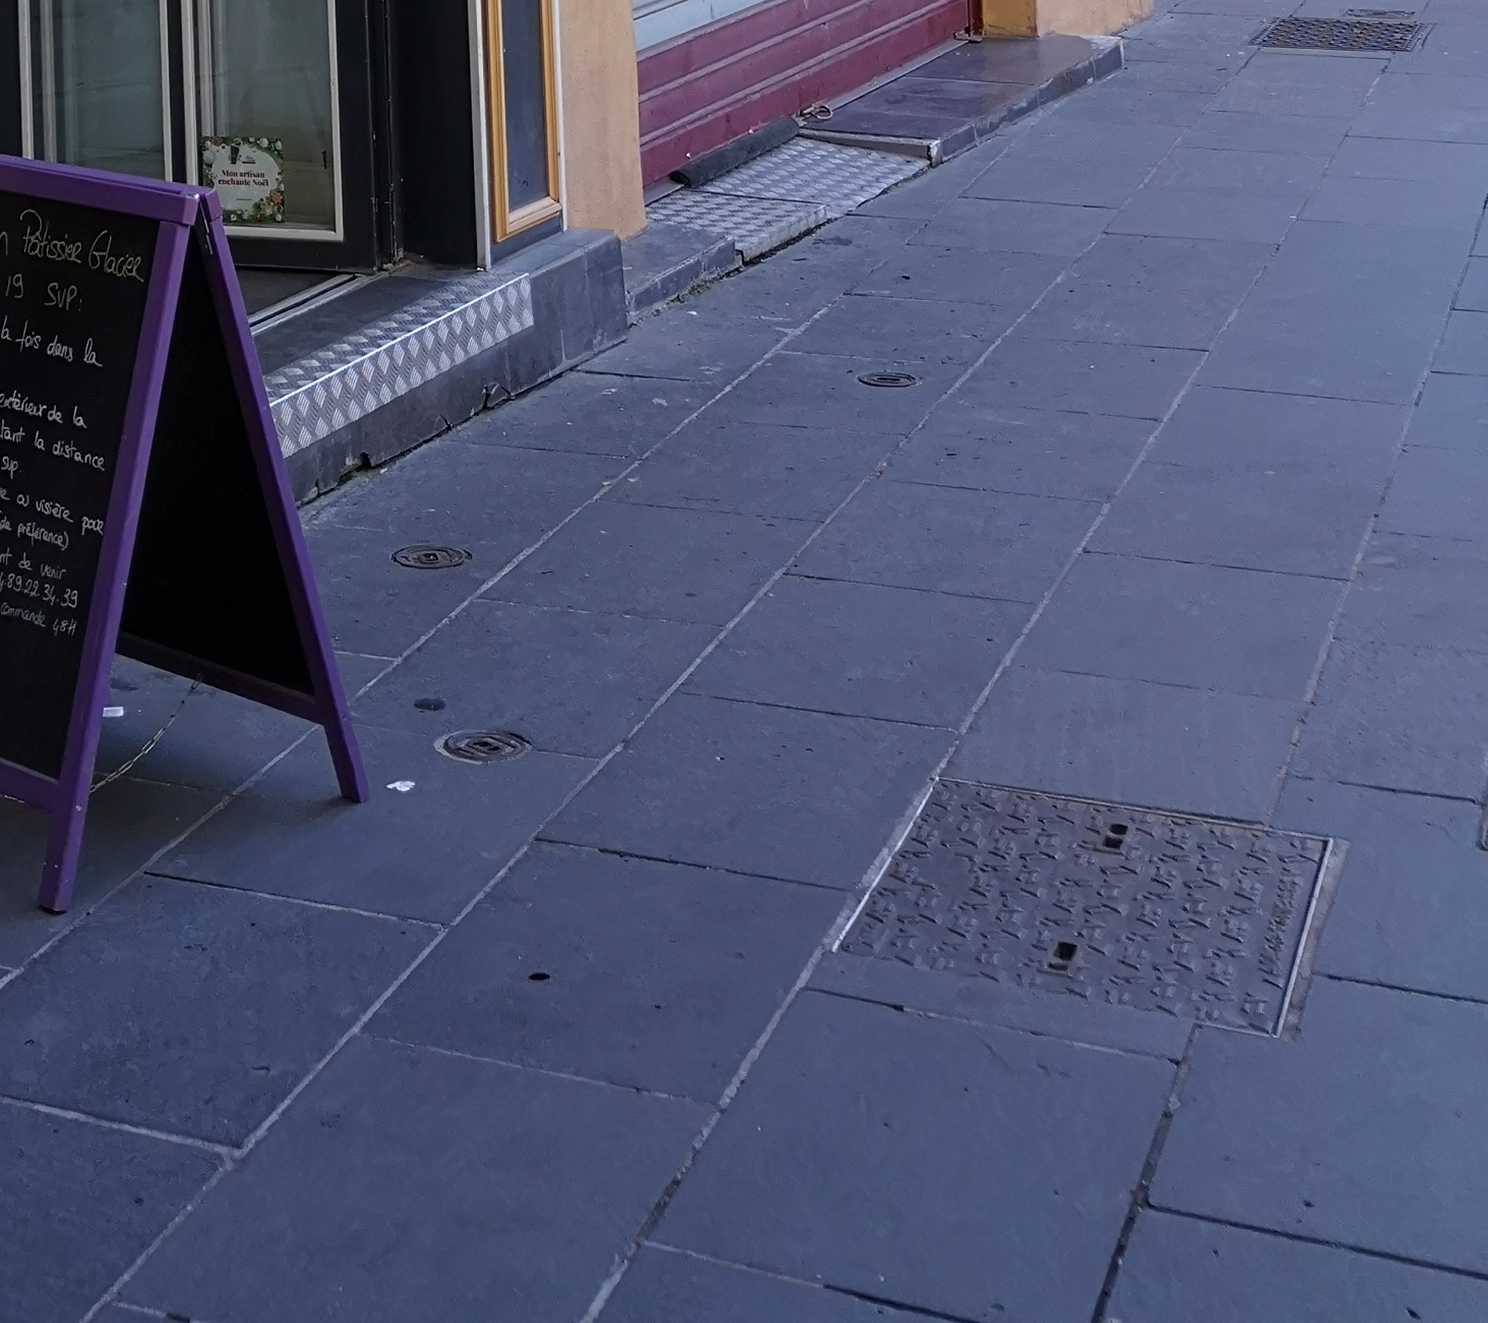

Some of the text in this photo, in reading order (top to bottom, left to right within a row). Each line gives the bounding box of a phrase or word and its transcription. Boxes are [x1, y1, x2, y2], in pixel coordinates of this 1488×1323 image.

[222, 169, 265, 178] Mon artisan
[252, 178, 269, 186] Noël
[5, 273, 24, 299] 19
[15, 320, 42, 353] fois
[47, 334, 74, 363] dans
[83, 337, 104, 368] la
[47, 405, 63, 425] de
[73, 406, 88, 429] la
[34, 430, 46, 451] la
[52, 440, 106, 472] distance
[16, 492, 30, 507] ou
[18, 551, 33, 571] de
[40, 563, 67, 580] venir
